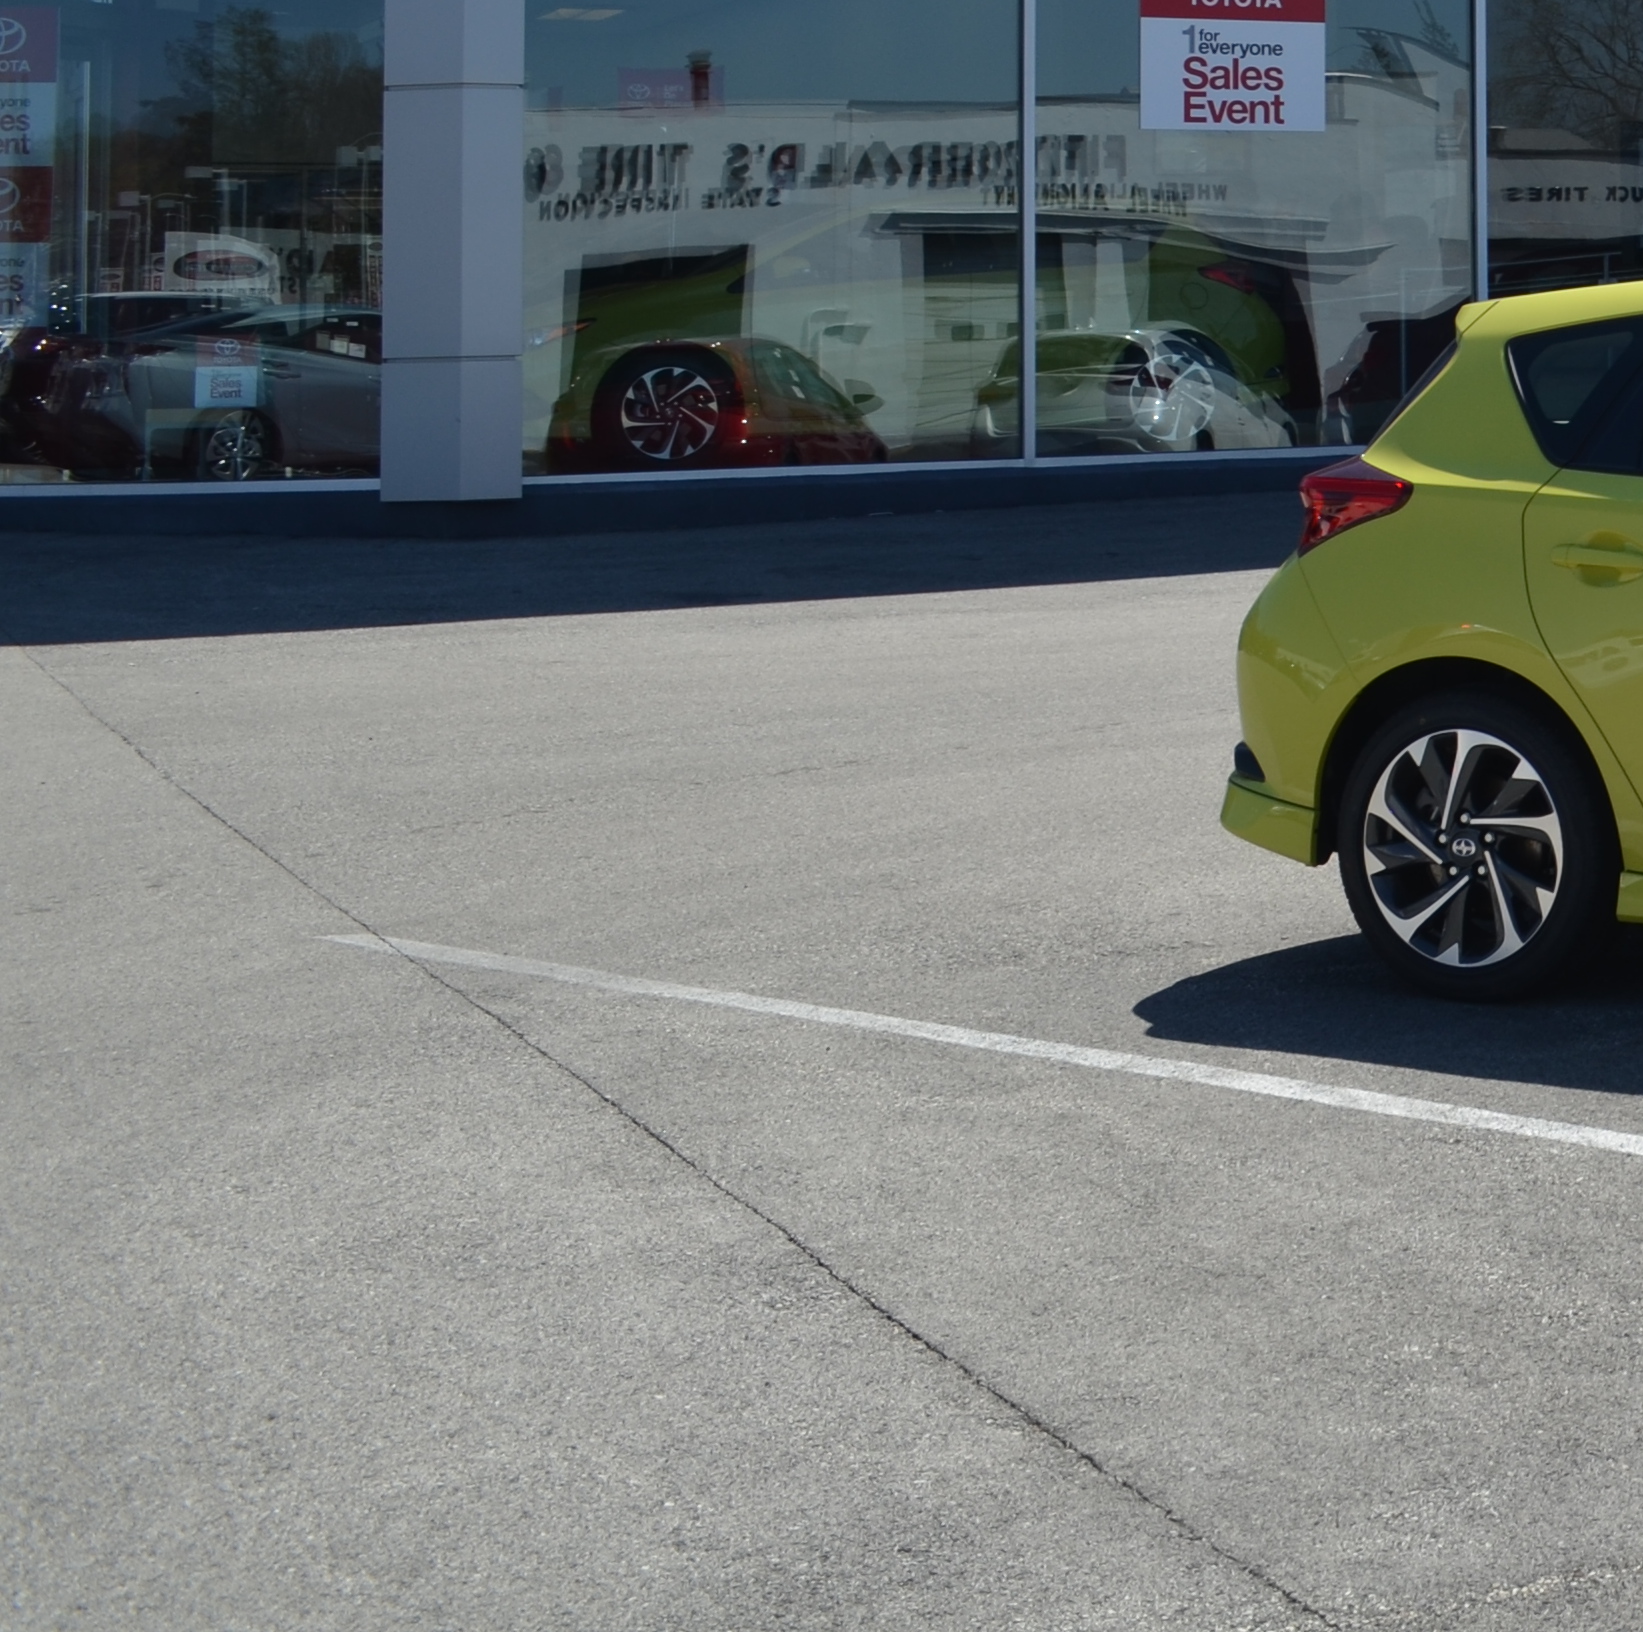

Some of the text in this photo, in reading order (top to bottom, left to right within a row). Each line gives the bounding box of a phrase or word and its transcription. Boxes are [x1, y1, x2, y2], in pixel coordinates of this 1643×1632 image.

[1182, 24, 1220, 53] 1 for
[1199, 41, 1283, 59] everyone
[1182, 56, 1284, 91] Sales
[1184, 91, 1285, 124] Event
[210, 378, 242, 389] Sales
[210, 389, 242, 399] Event
